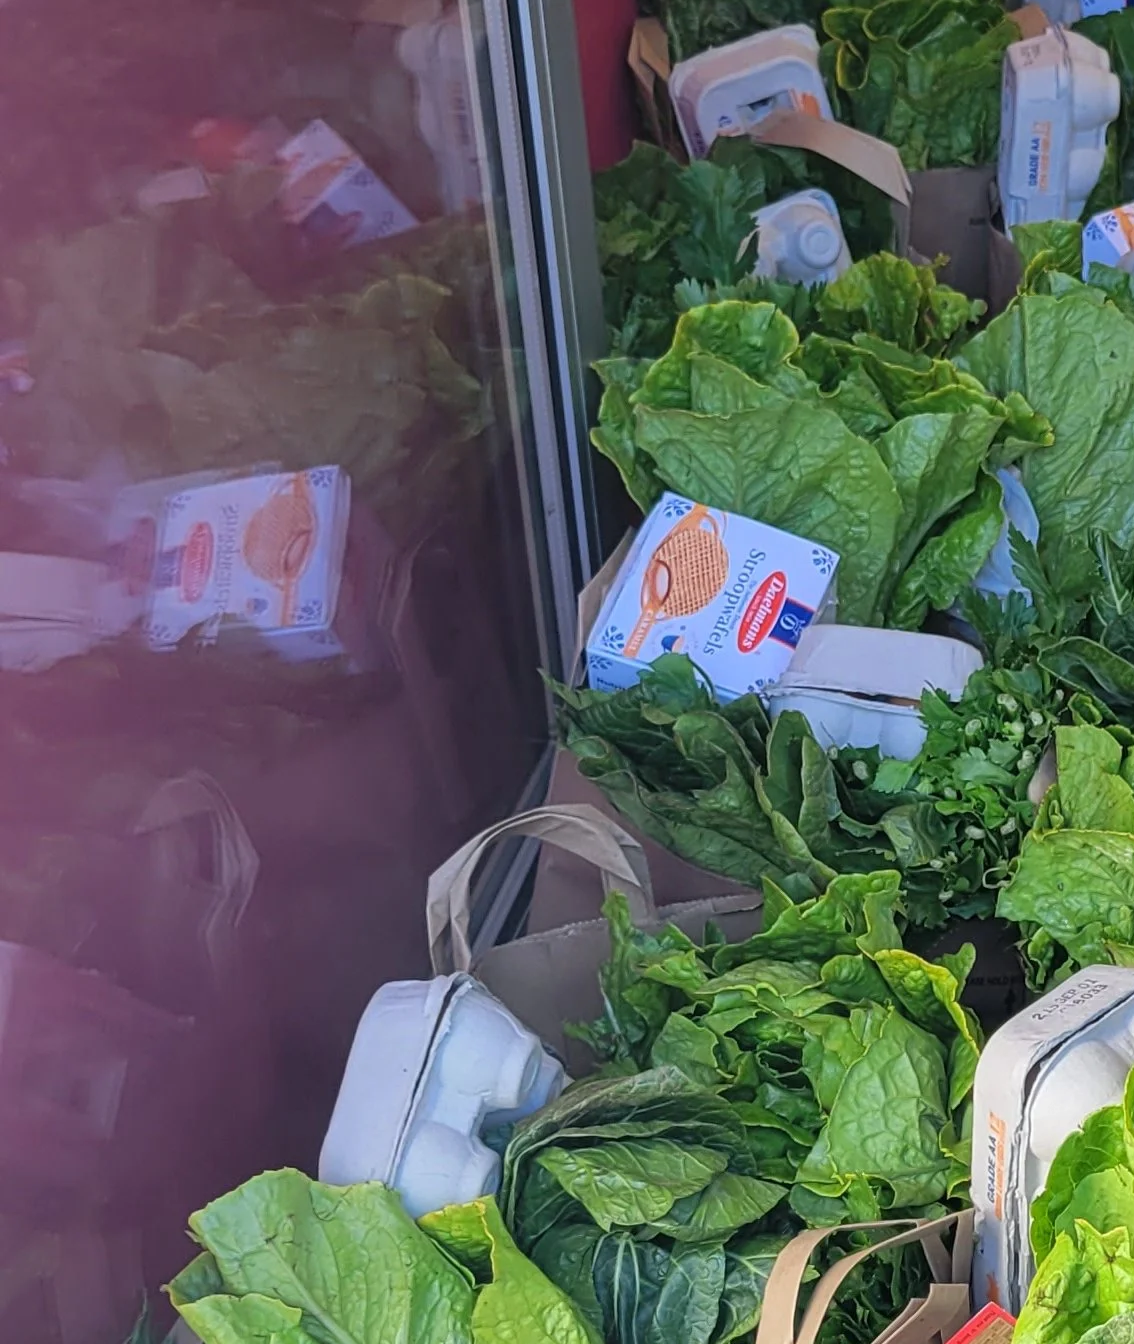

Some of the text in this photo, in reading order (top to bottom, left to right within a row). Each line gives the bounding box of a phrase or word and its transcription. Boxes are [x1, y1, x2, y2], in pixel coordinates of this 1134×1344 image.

[1028, 138, 1040, 187] GRADE AA
[703, 547, 766, 656] Stroopwafels
[741, 575, 785, 650] Daelmans
[988, 1135, 997, 1154] AA
[986, 1156, 996, 1204] GRADE
